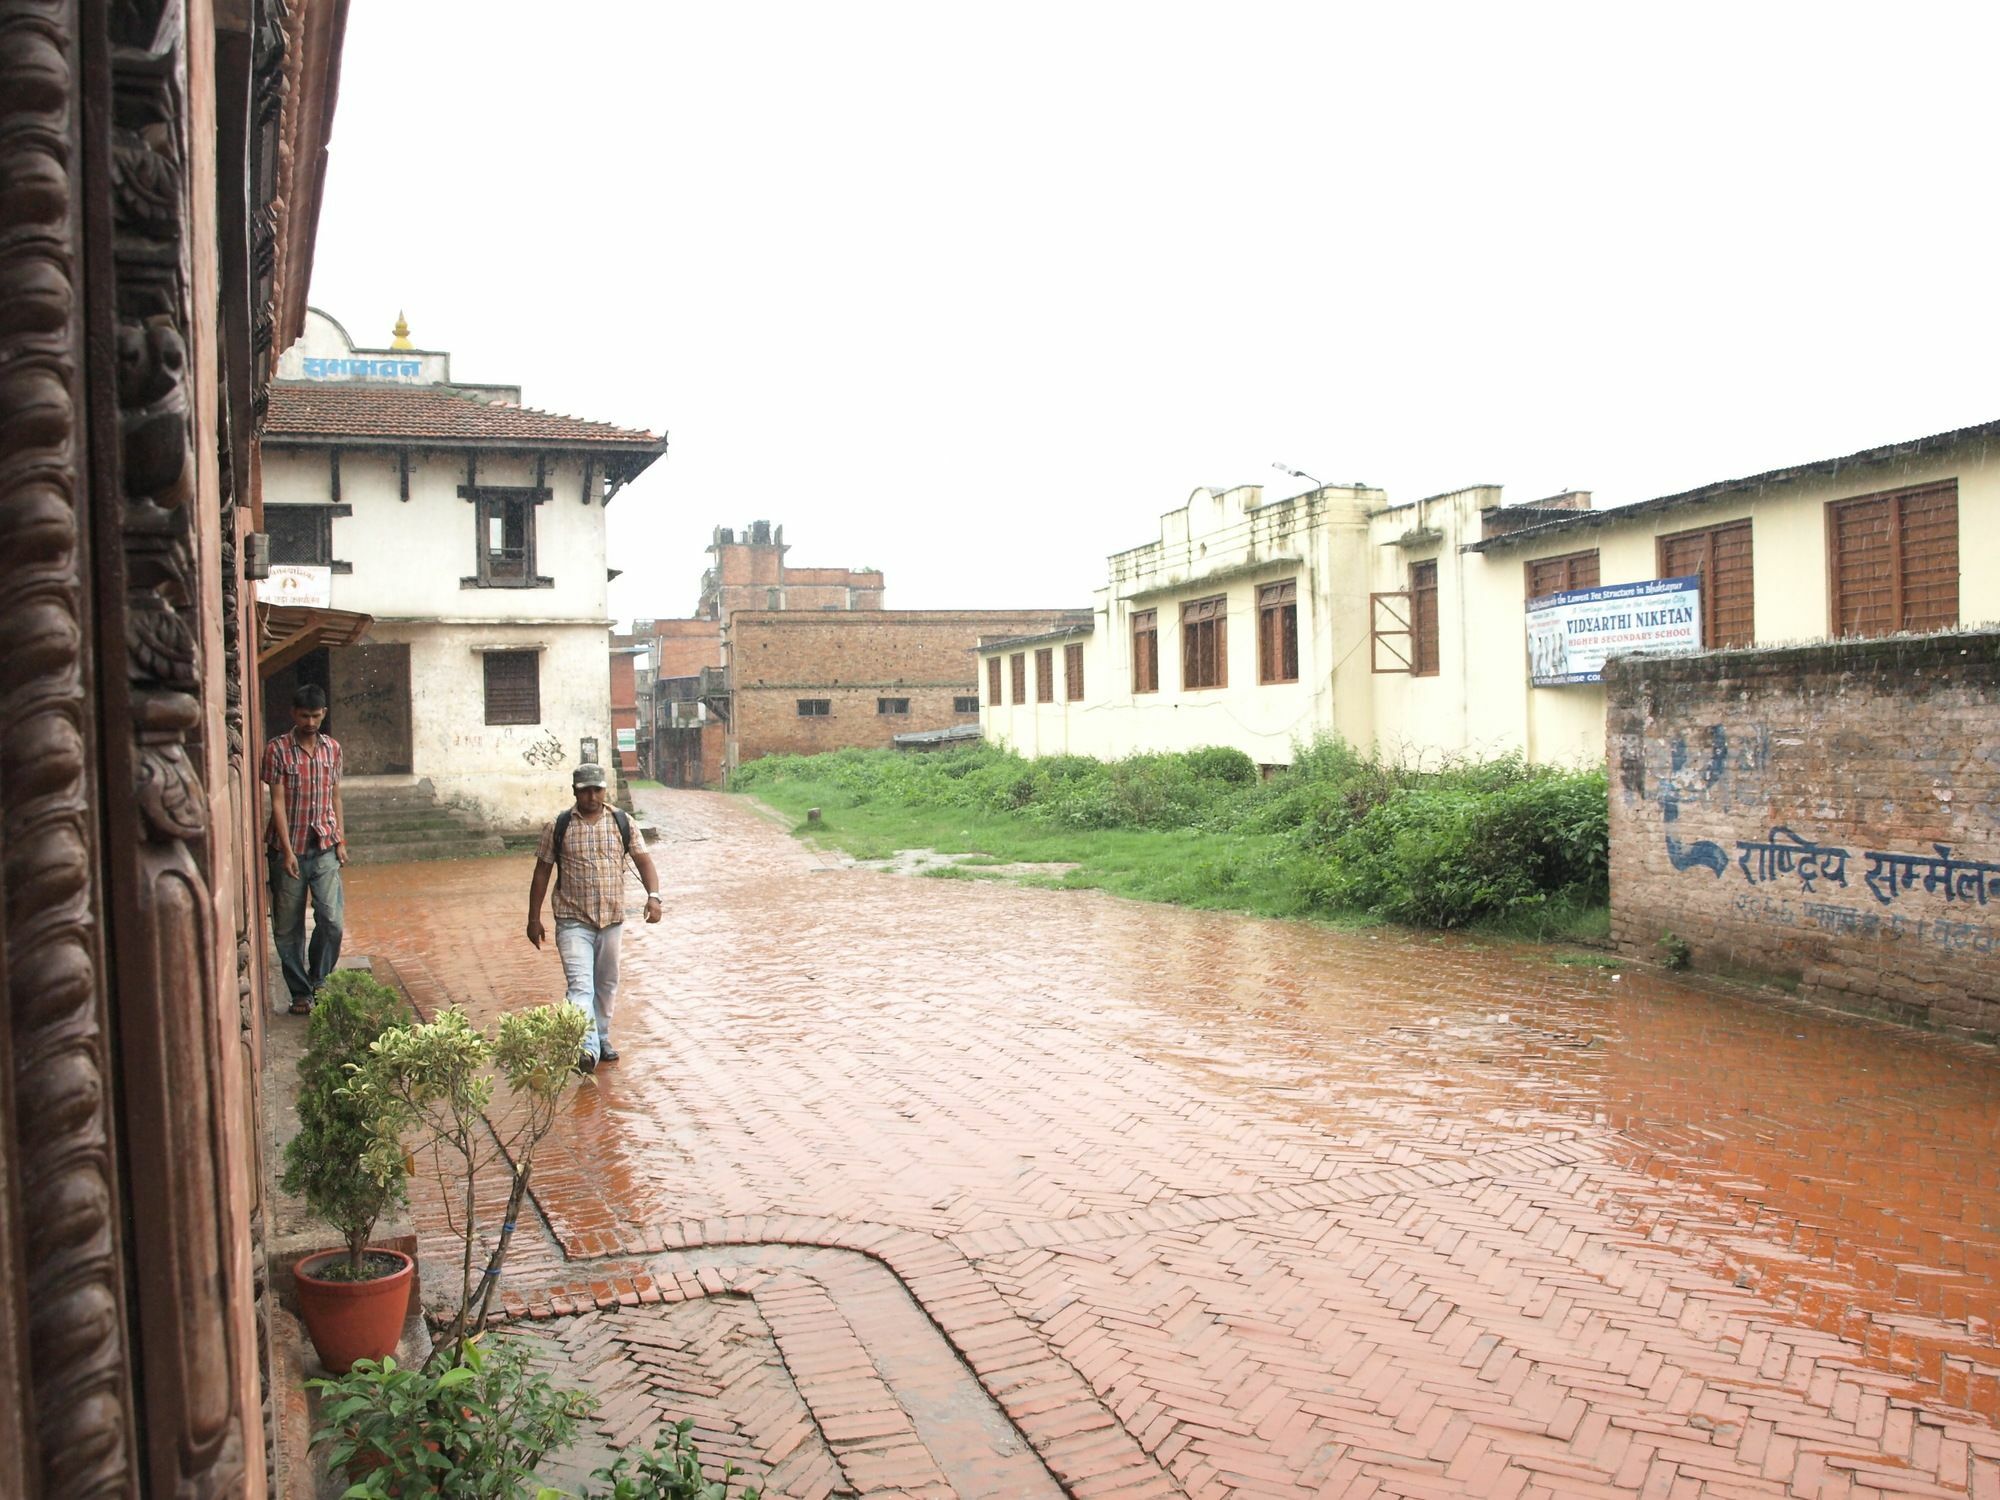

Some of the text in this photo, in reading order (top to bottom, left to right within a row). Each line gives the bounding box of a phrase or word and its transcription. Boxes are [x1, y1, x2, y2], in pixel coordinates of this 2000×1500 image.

[1567, 592, 1589, 603] Lowest
[1590, 590, 1602, 602] Fee
[1603, 588, 1635, 600] Structure
[1636, 585, 1644, 595] in
[1646, 581, 1683, 595] Bhaktapur
[1672, 594, 1687, 608] City
[1567, 614, 1631, 634] VIDYARTHI
[1636, 607, 1693, 628] NIKETAN
[1568, 627, 1691, 647] HIGHER SECONDARY SCHOOL
[1736, 826, 1851, 894] राष्ट्रिय
